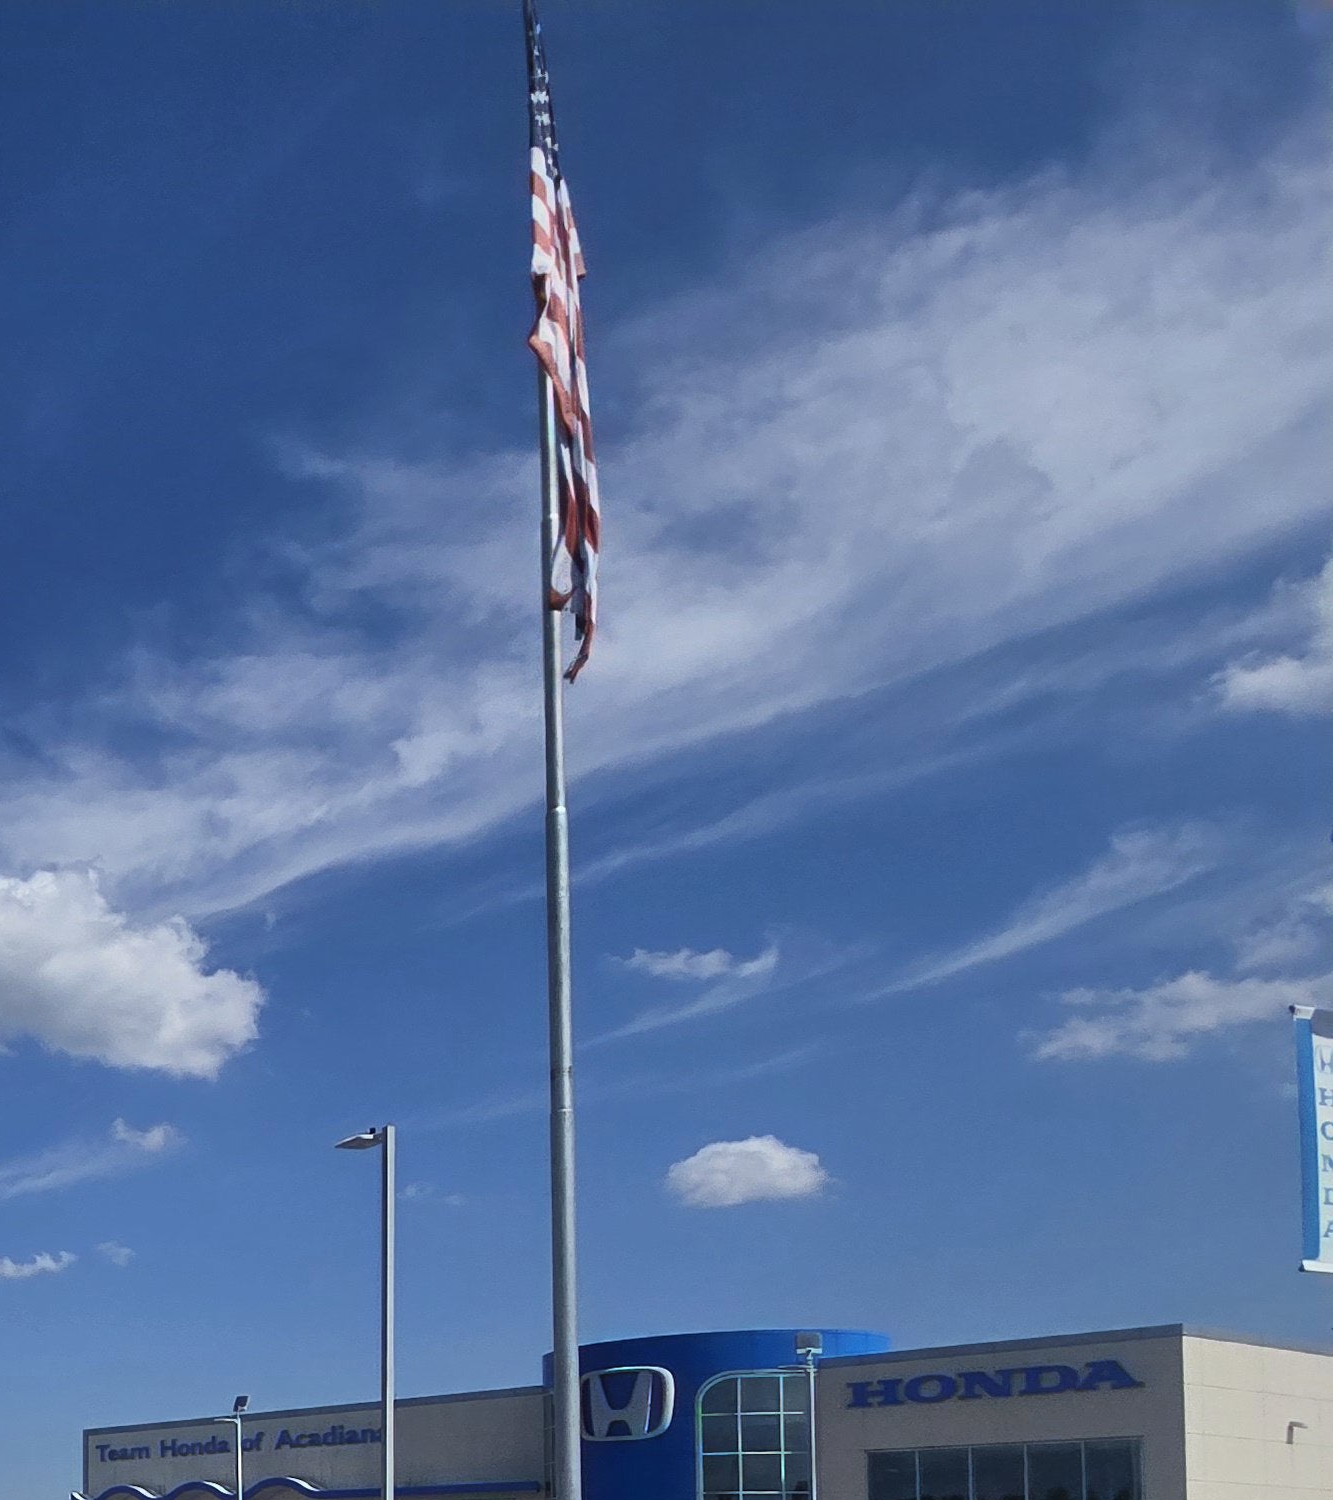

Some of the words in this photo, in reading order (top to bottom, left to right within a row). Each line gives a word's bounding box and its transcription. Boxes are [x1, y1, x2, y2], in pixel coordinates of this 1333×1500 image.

[846, 1359, 1145, 1409] HONDA
[95, 1443, 151, 1463] Team
[159, 1435, 231, 1458] Honda
[241, 1431, 265, 1452] of
